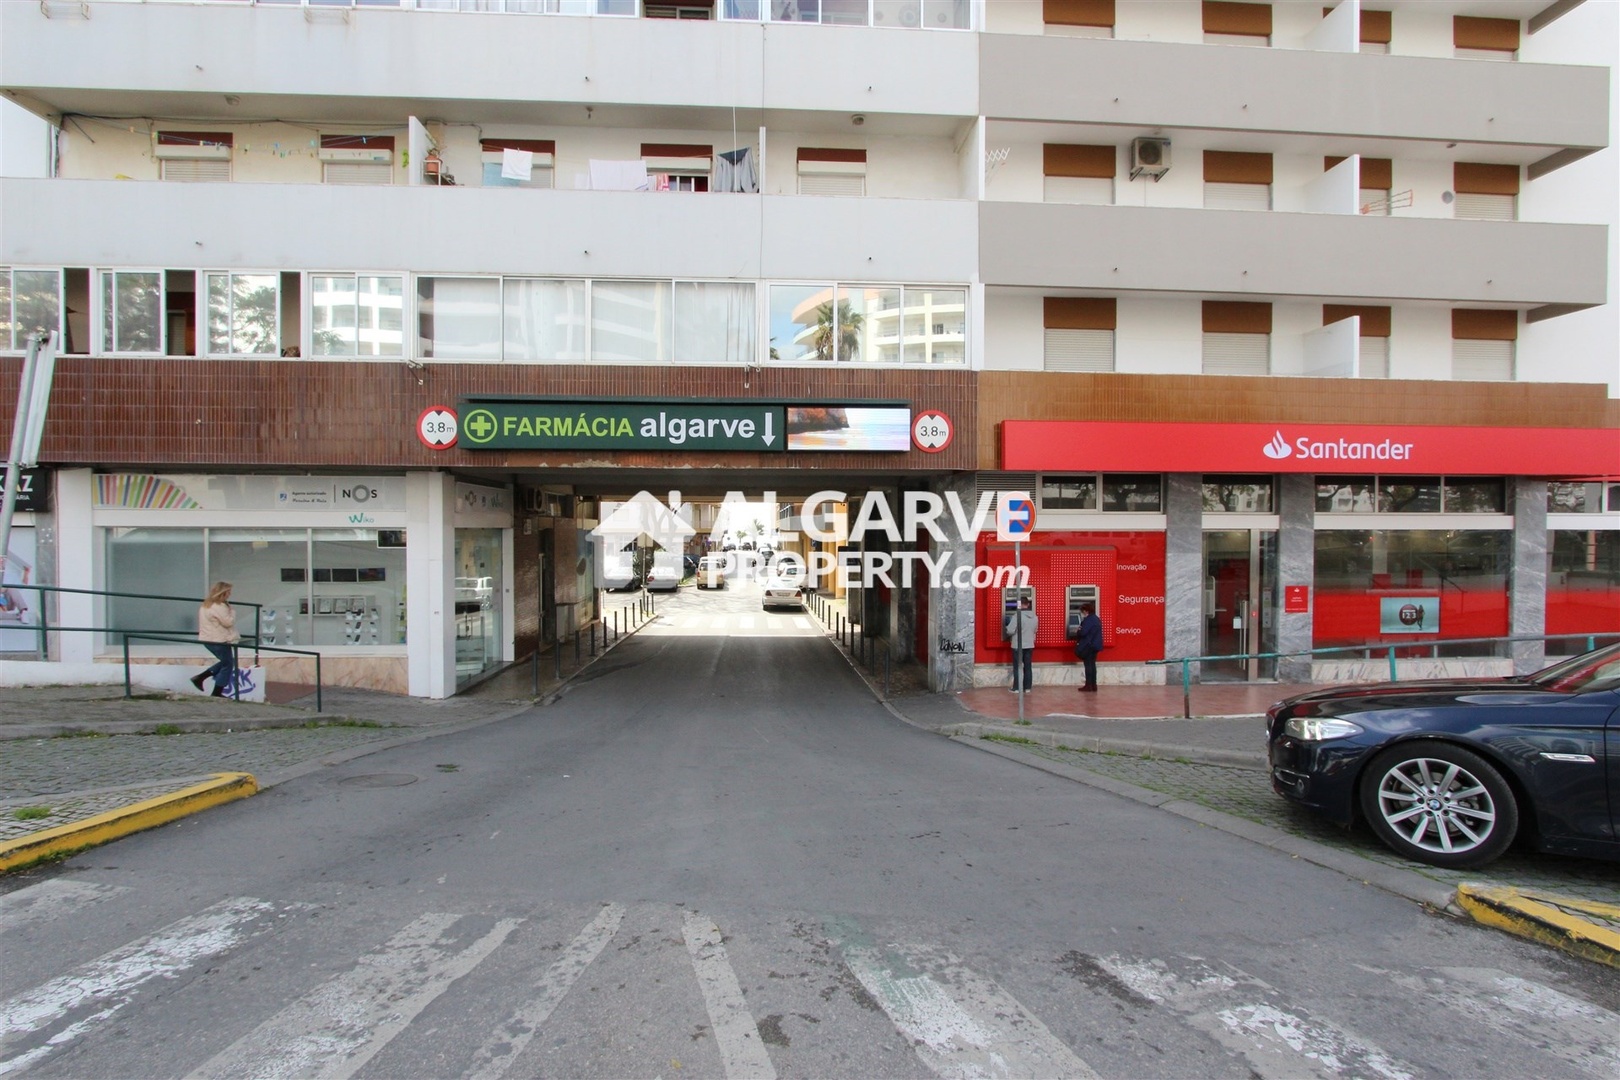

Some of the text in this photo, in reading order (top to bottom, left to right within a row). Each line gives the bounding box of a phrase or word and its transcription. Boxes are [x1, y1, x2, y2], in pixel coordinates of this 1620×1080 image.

[503, 412, 756, 444] FARMÁCIA algarve
[1295, 437, 1414, 460] Santander
[342, 484, 378, 503] NOS
[1116, 564, 1147, 572] Inovação
[1118, 594, 1165, 605] Segurança
[1115, 626, 1142, 635] Serviço
